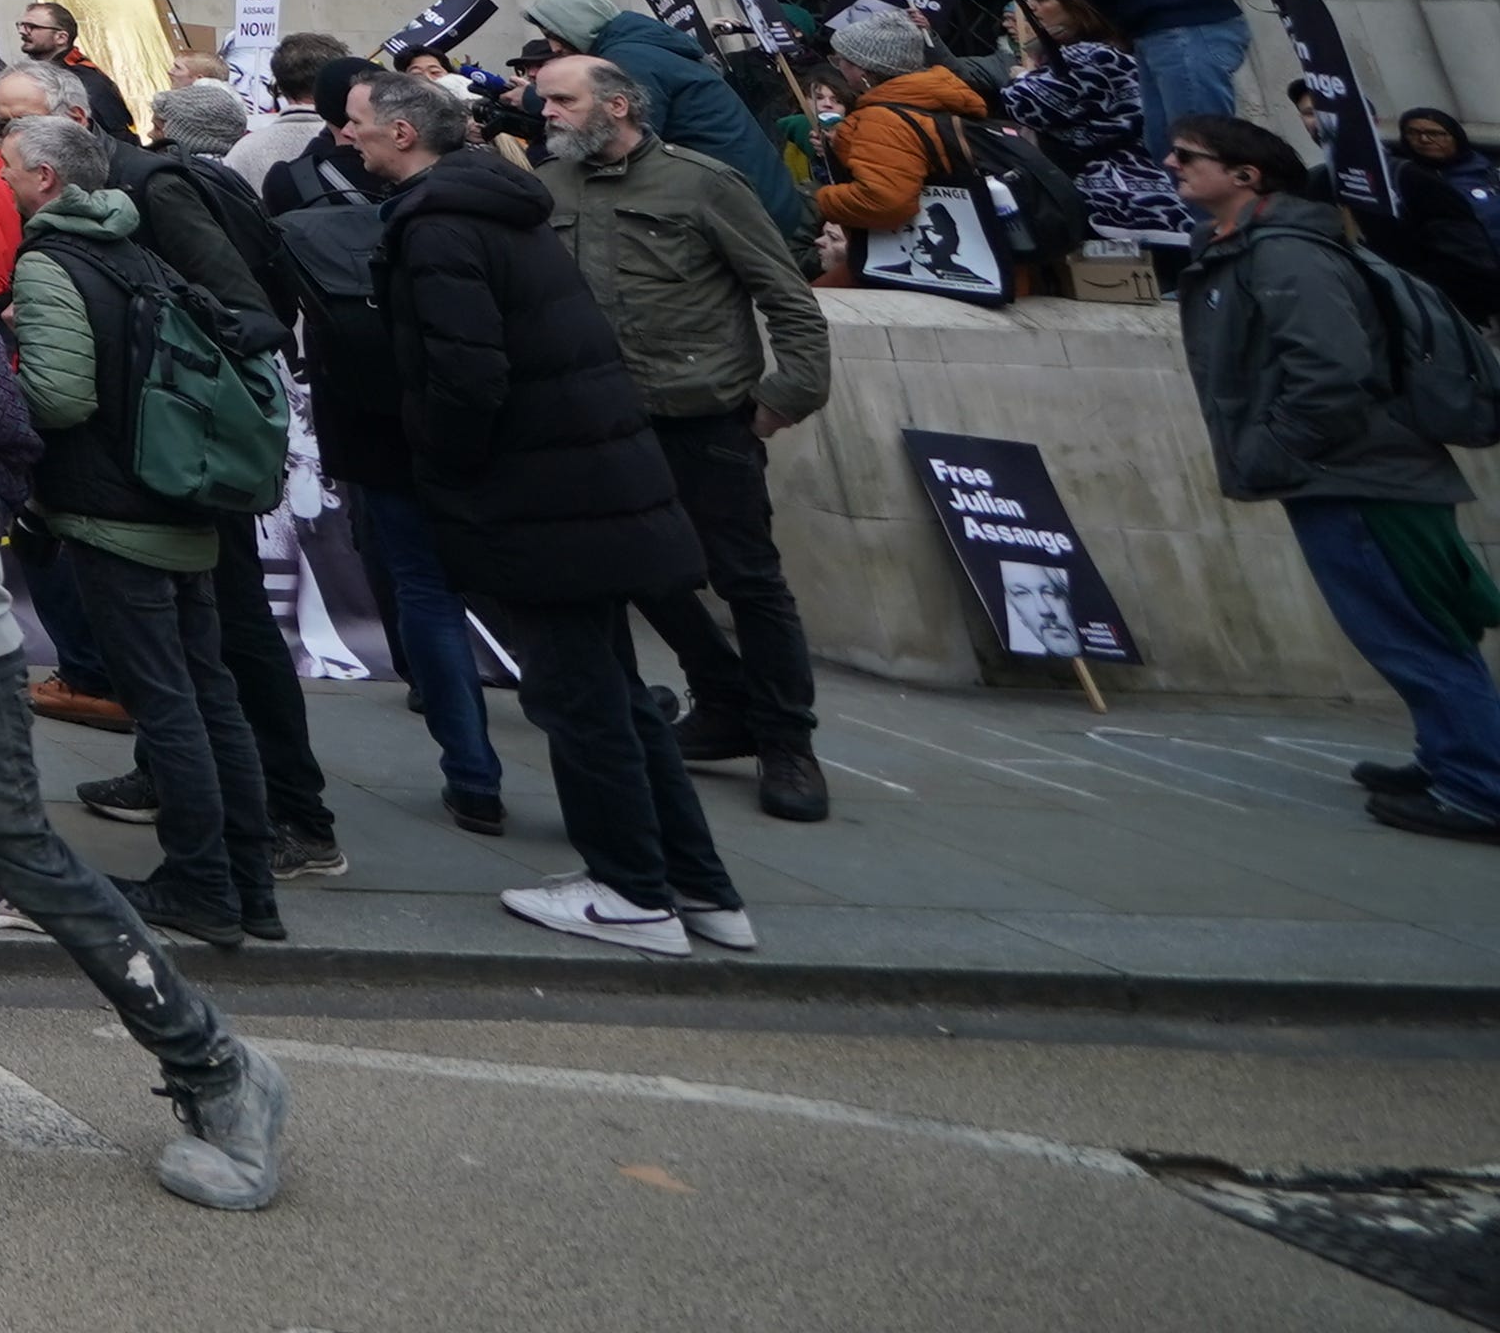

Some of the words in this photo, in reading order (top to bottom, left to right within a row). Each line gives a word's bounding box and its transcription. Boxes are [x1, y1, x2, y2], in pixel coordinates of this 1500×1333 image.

[240, 22, 275, 37] NOW!
[928, 458, 993, 487] Free
[949, 487, 1027, 519] Julian
[962, 515, 1073, 555] Assange
